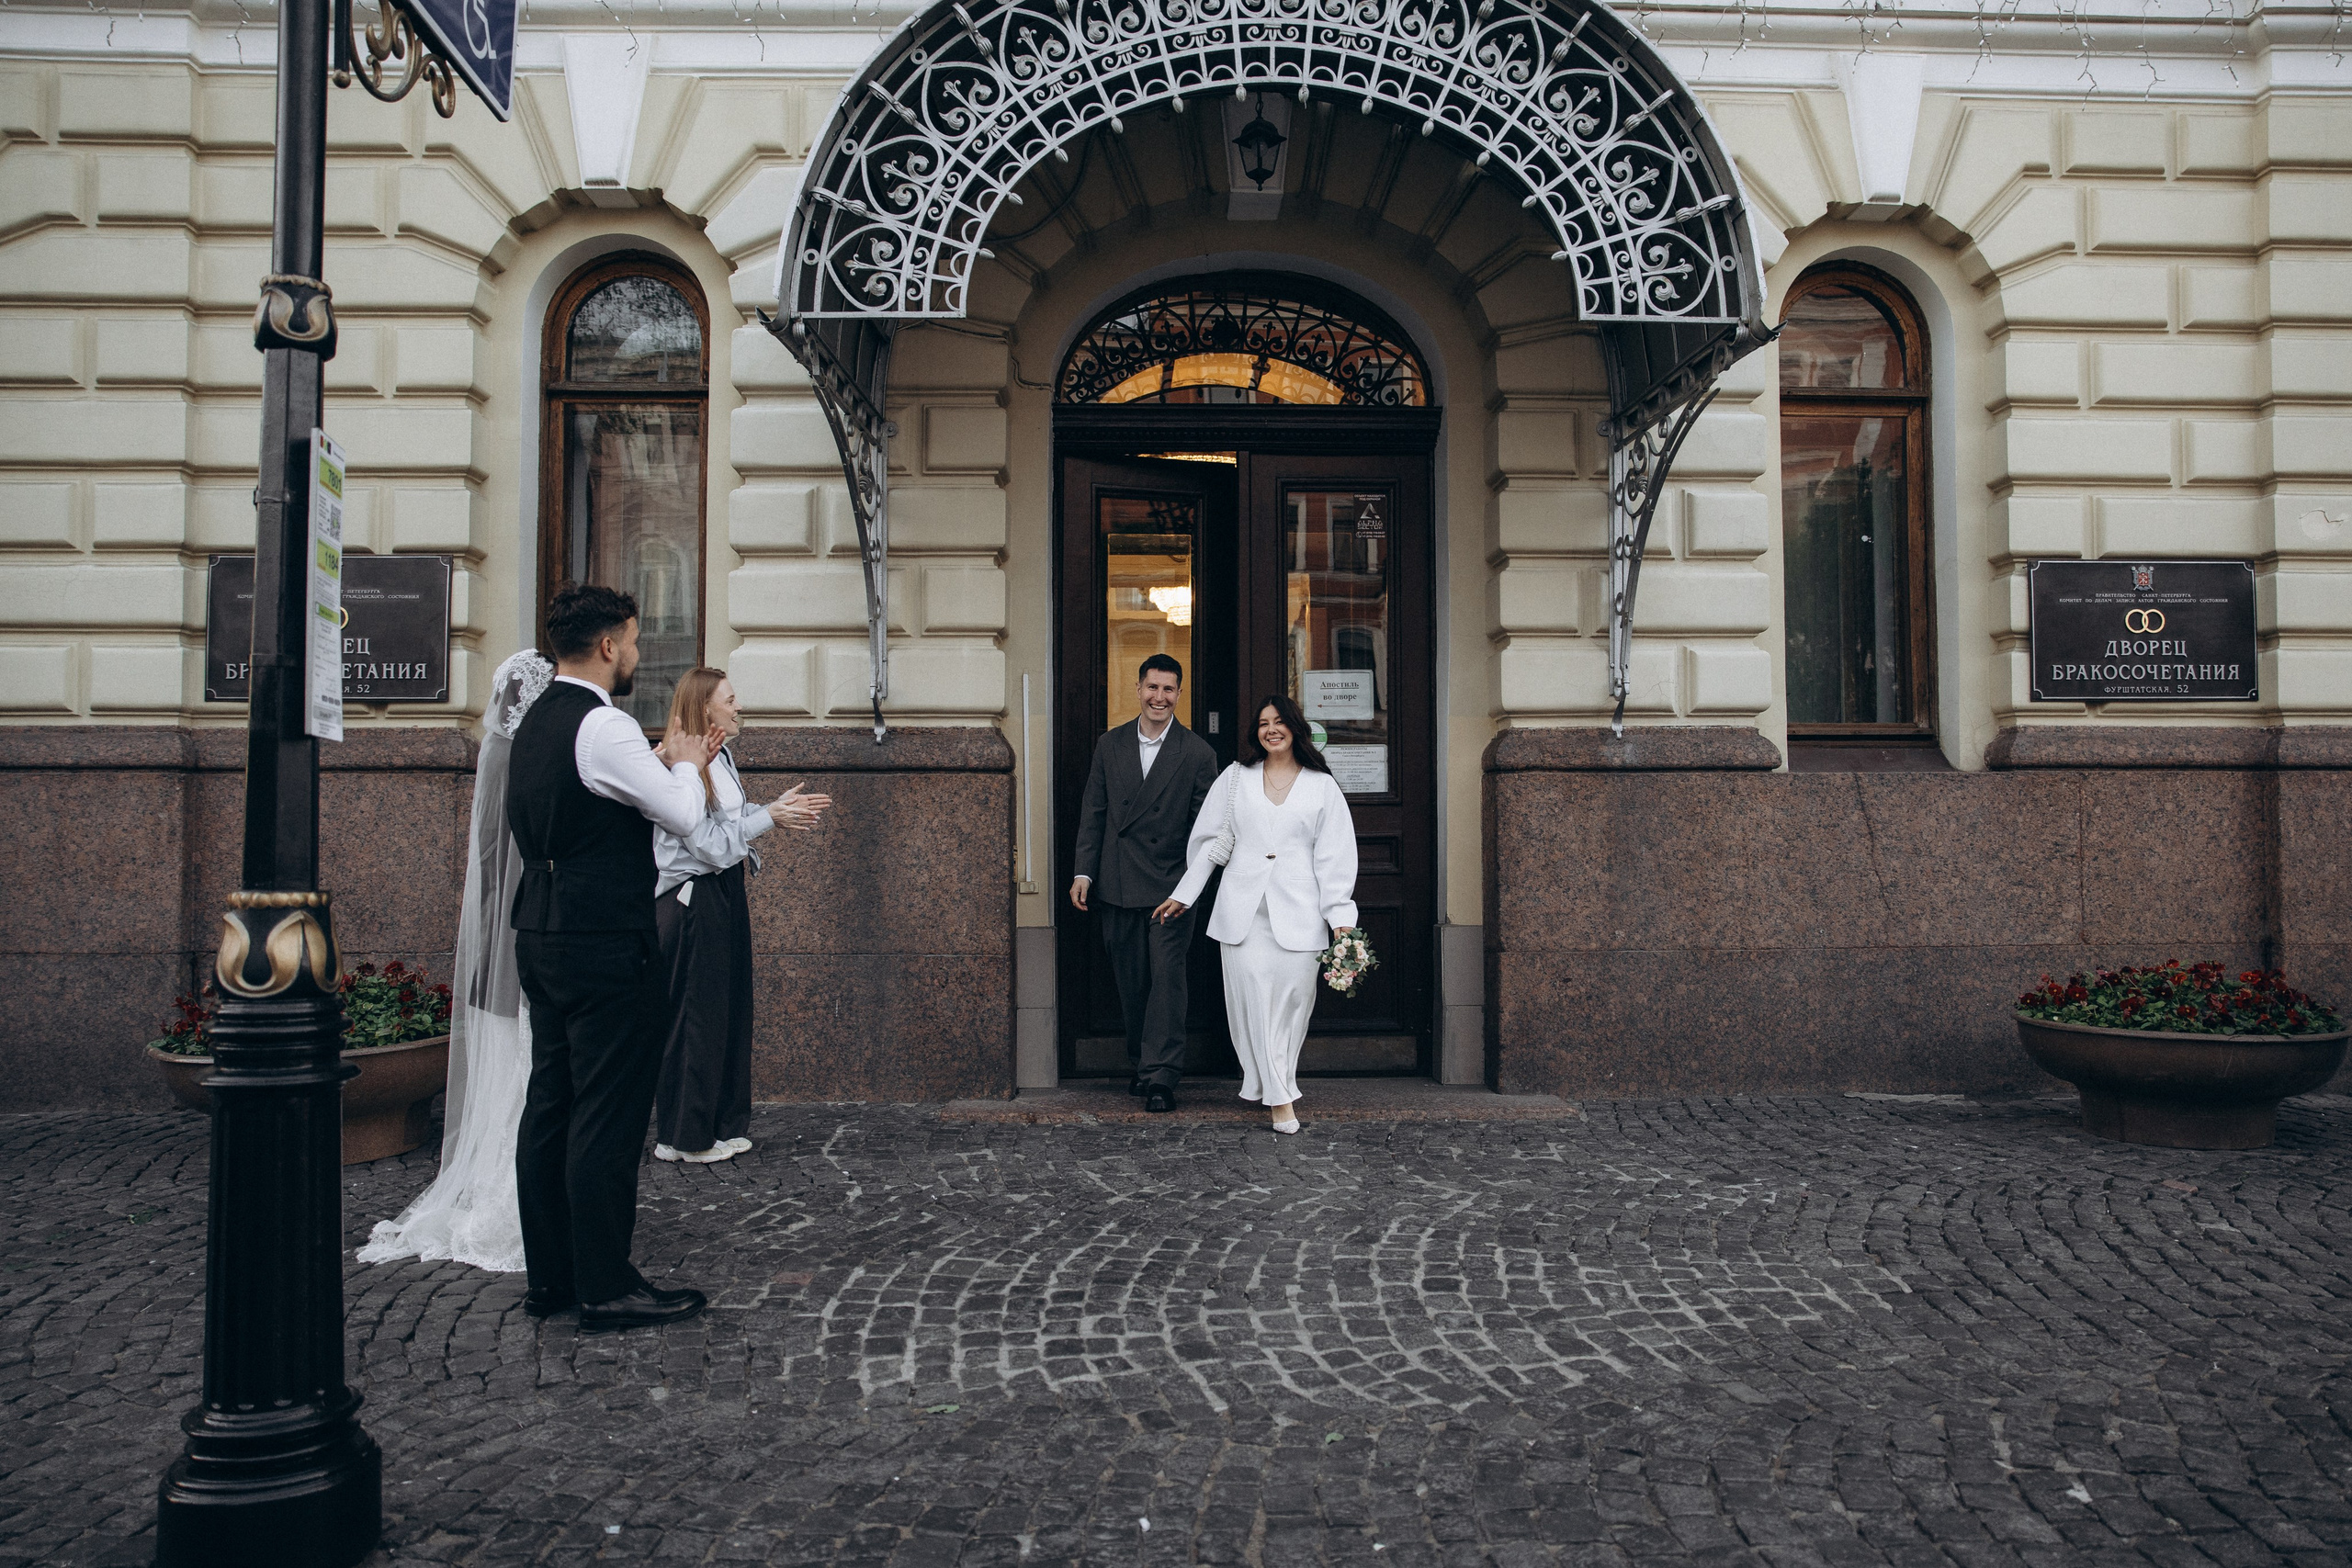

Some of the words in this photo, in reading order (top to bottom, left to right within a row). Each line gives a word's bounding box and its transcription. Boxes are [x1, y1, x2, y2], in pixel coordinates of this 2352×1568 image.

[2104, 640, 2188, 658] ДВОРЕЦ
[2052, 664, 2240, 681] БРАКОСОЧЕТАНИЯ
[356, 684, 370, 693] 52
[2177, 685, 2189, 694] 52
